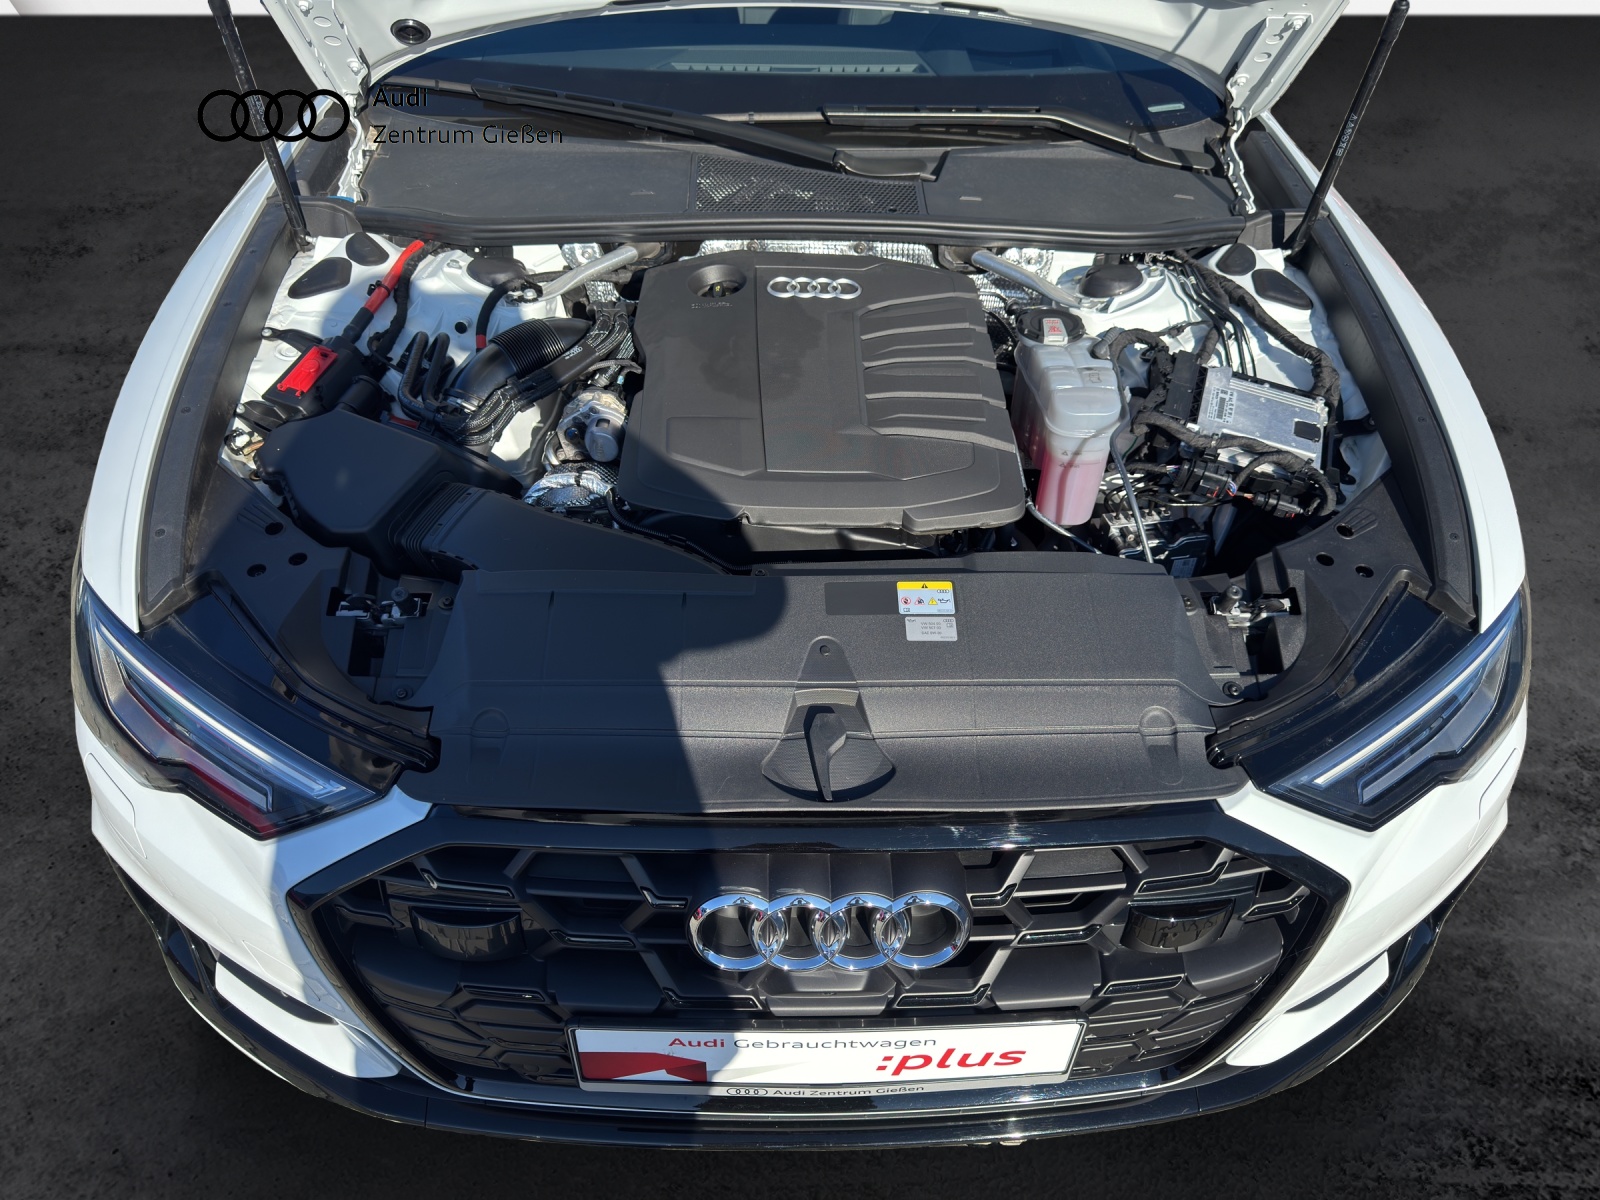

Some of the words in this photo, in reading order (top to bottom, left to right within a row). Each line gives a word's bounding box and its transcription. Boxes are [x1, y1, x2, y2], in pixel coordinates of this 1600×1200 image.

[668, 1037, 725, 1048] Audi
[734, 1038, 937, 1049] Gebrauchtwagen
[876, 1086, 924, 1094] Gießen
